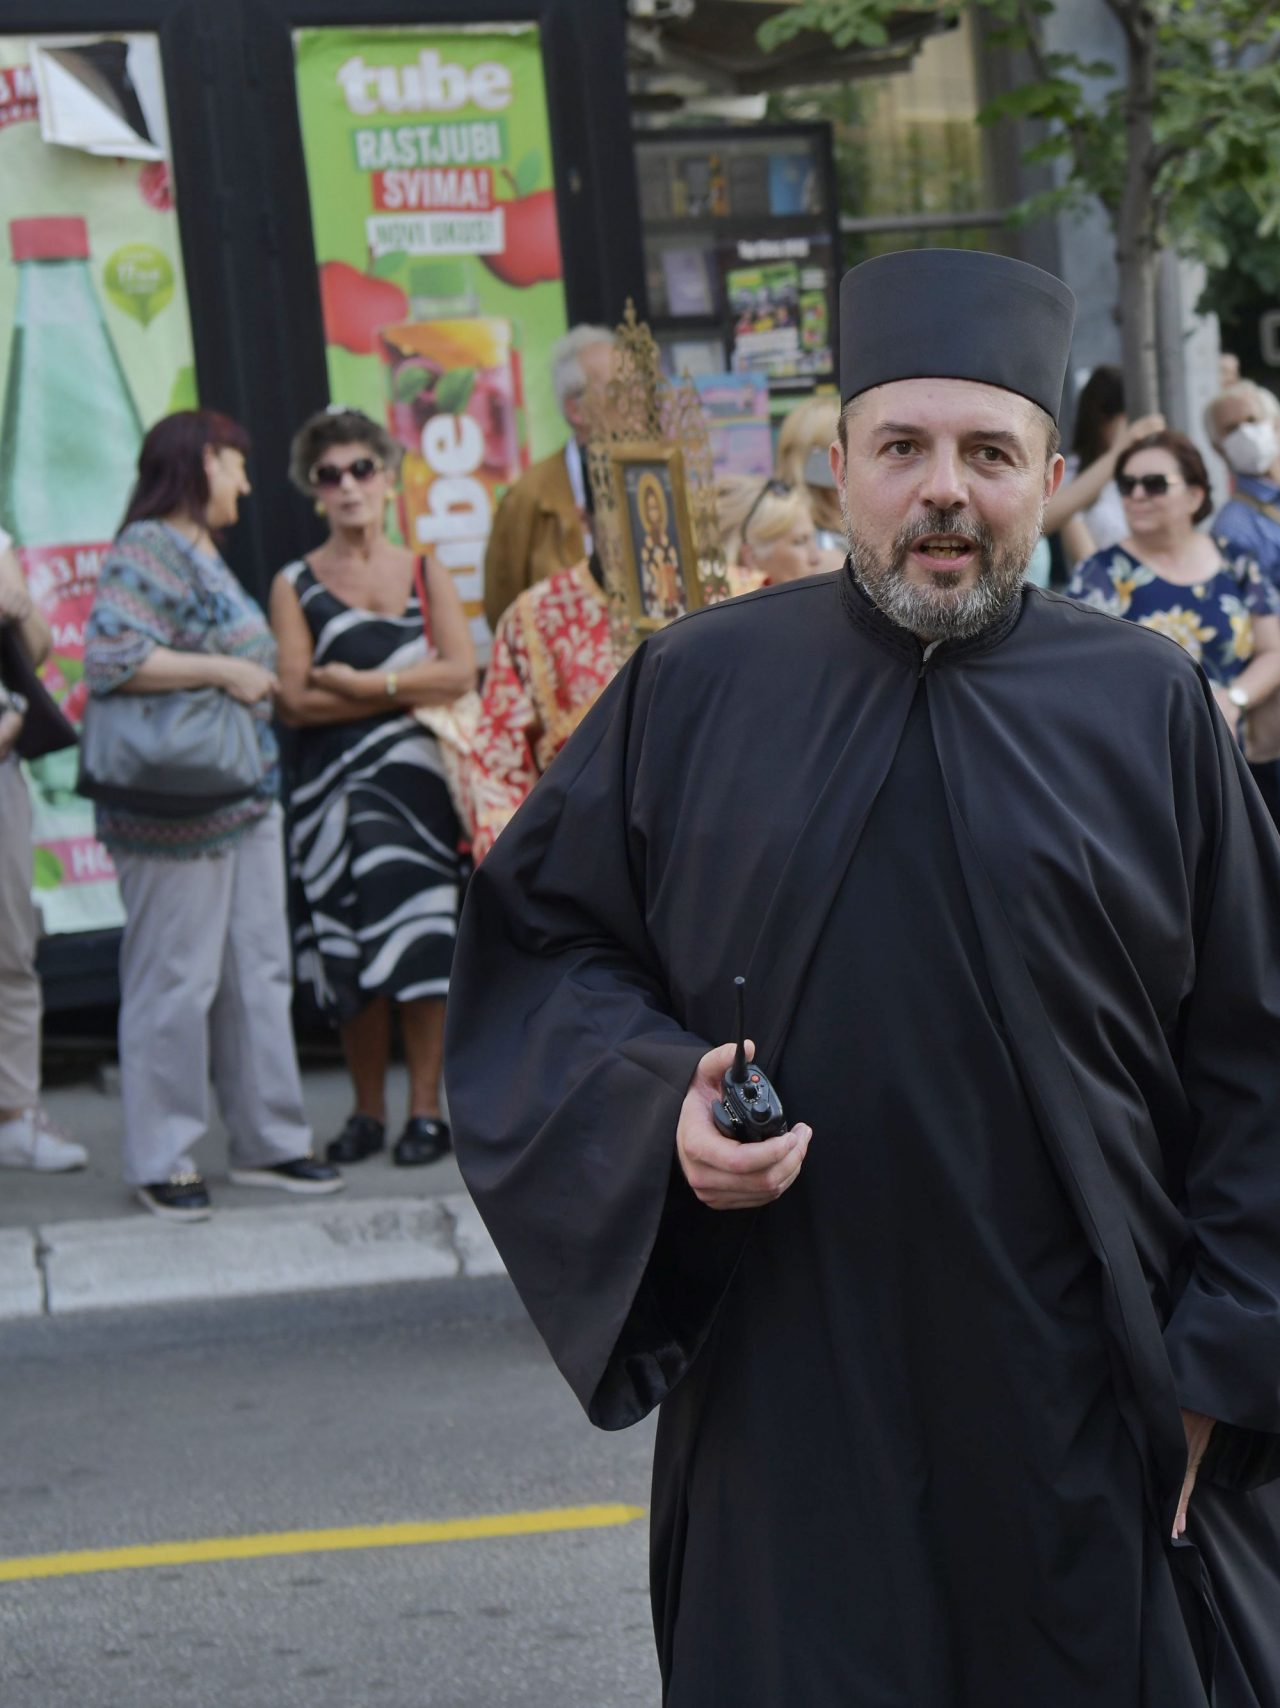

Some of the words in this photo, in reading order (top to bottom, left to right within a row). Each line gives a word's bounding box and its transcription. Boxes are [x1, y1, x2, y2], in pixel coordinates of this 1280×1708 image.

[337, 48, 511, 114] tube
[355, 121, 500, 170] RASTJUBI
[382, 170, 491, 209] SVIMA!
